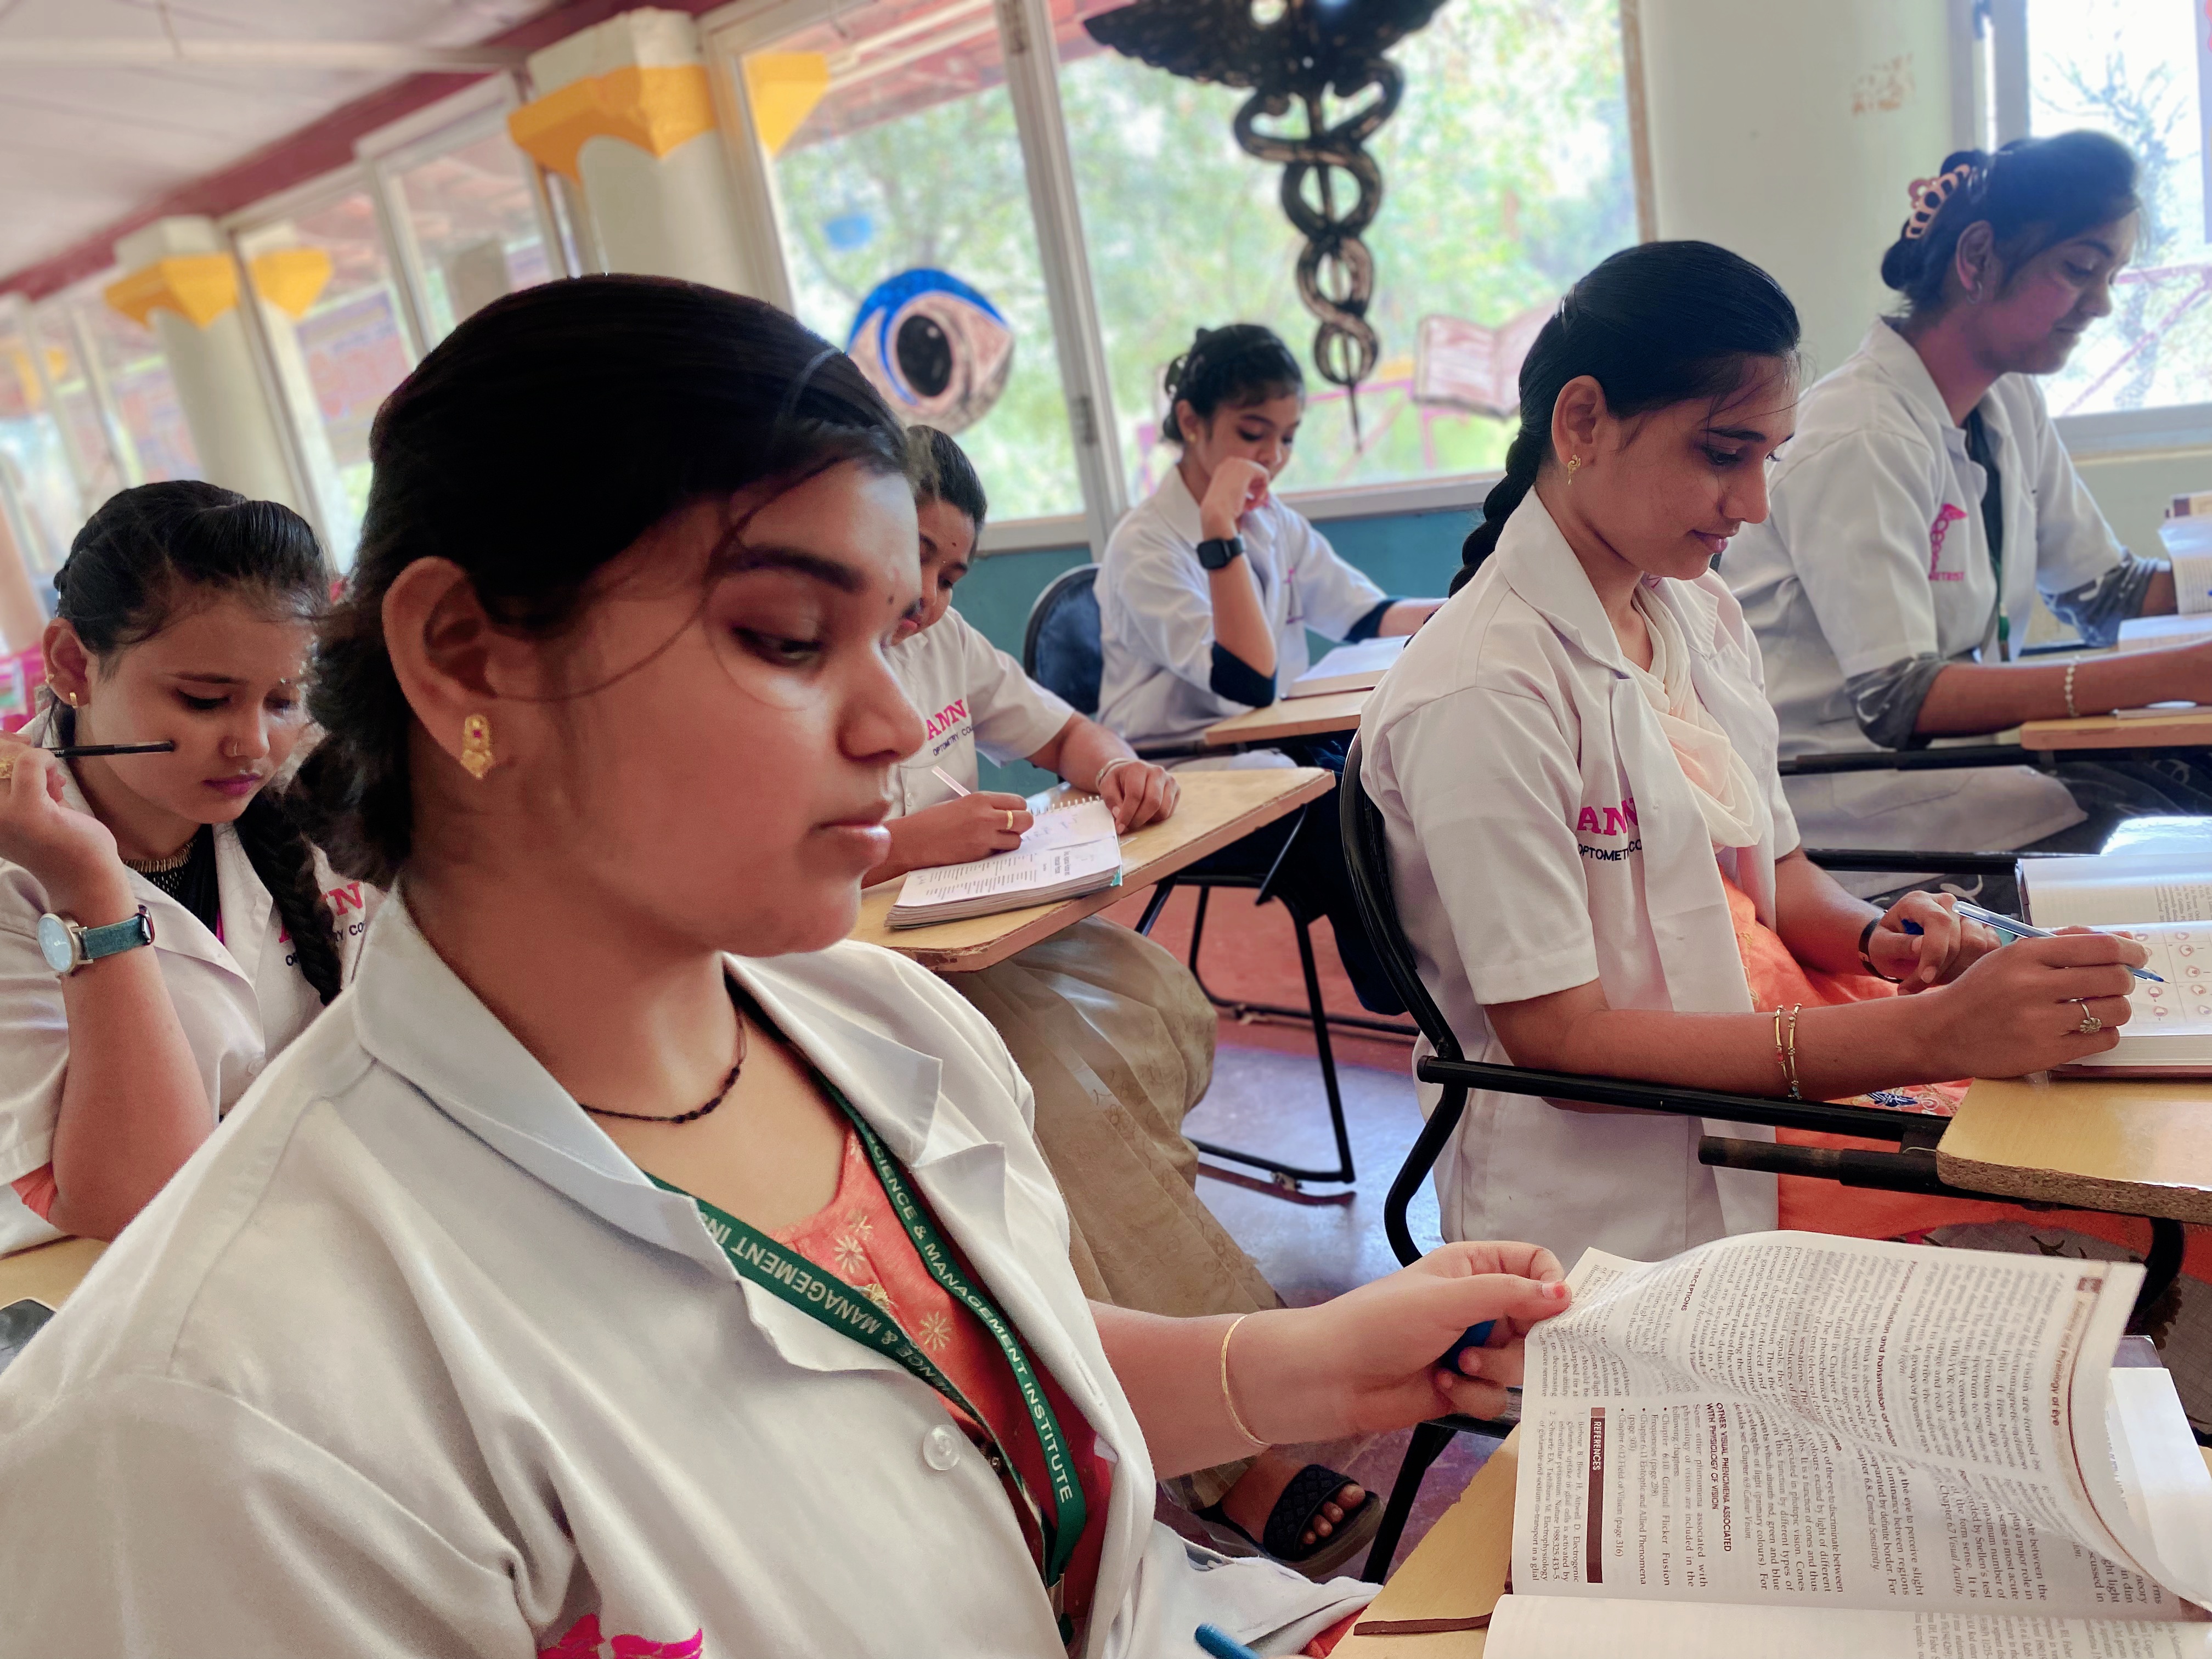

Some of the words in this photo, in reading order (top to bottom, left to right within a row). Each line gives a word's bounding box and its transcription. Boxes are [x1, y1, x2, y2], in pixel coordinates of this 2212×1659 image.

[926, 699, 970, 741] ANN
[933, 732, 960, 756] OPTOMETRY
[1578, 844, 1629, 861] OPTOMET
[730, 1237, 883, 1335] MANAGEMENT
[1681, 1268, 1702, 1311] PERCEPTIONS
[1757, 1322, 1767, 1366] produced
[1787, 1330, 1797, 1379] transducers
[913, 1225, 927, 1240] &
[924, 1243, 1028, 1375] MANAGEMENT
[1024, 1381, 1073, 1504] INSTITUTE
[1747, 1344, 1758, 1392] transmitted
[1807, 1355, 1818, 1398] (electrical
[1819, 1337, 1830, 1402] photochemical
[1828, 1356, 1838, 1393] Chapter
[1757, 1372, 1766, 1389] and
[1706, 1403, 1716, 1423] WITH
[1716, 1403, 1727, 1428] OTHER
[1592, 1421, 1602, 1471] REFERENCES
[1709, 1425, 1718, 1470] PHYSIOLOGY
[1722, 1458, 1730, 1503] PHENOMENA
[1711, 1485, 1719, 1510] VISION
[1615, 1517, 1624, 1538] (page
[1662, 1515, 1670, 1544] Flicker
[1685, 1514, 1694, 1551] included
[1697, 1513, 1706, 1557] associated
[1723, 1505, 1732, 1551] ASSOCIATED
[1767, 1521, 1775, 1543] green
[1780, 1511, 1789, 1546] different
[1880, 1511, 1890, 1541] definite
[1893, 1517, 1904, 1553] between
[1900, 1479, 1910, 1493] the
[1905, 1526, 1918, 1562] perceive
[1912, 1567, 1925, 1596] slight
[1997, 1514, 2010, 1537] sense
[1539, 1516, 1551, 1581] Electrophysiology
[1561, 1535, 1570, 1567] activated
[1571, 1536, 1581, 1582] Electrogenic
[1615, 1541, 1623, 1557] 316)
[1639, 1535, 1647, 1585] Phenomena
[1770, 1548, 1778, 1564] and
[1807, 1551, 1816, 1566] and
[1883, 1543, 1894, 1575] border.
[1949, 1536, 1961, 1561] Visual
[1963, 1542, 1972, 1571] sense.
[1982, 1503, 1996, 1545] maximum
[1990, 1548, 2003, 1585] number
[1997, 1589, 2007, 1600] of
[2004, 1548, 2015, 1570] most
[2015, 1541, 2028, 1566] major
[1531, 1563, 1539, 1581] glial
[1560, 1572, 1569, 1582] by
[1662, 1553, 1671, 1586] Fusion
[1699, 1565, 1708, 1587] with
[1781, 1551, 1792, 1576] types
[1796, 1561, 1805, 1591] Cones
[1819, 1551, 1832, 1592] different
[1833, 1554, 1844, 1592] between
[1897, 1558, 1909, 1595] regions
[2022, 1568, 2032, 1587] role
[2029, 1539, 2044, 1579] between
[2038, 1584, 2048, 1600] the
[1686, 1571, 1695, 1587] the
[1759, 1573, 1768, 1590] For
[1772, 1569, 1781, 1590] blue
[1810, 1571, 1818, 1592] thus
[1888, 1579, 1897, 1595] For
[1982, 1581, 1992, 1598] test
[2008, 1573, 2019, 1600] acute
[2106, 1579, 2120, 1602] light
[2123, 1583, 2134, 1603] dim
[2024, 1590, 2034, 1600] in
[2096, 1593, 2104, 1602] in
